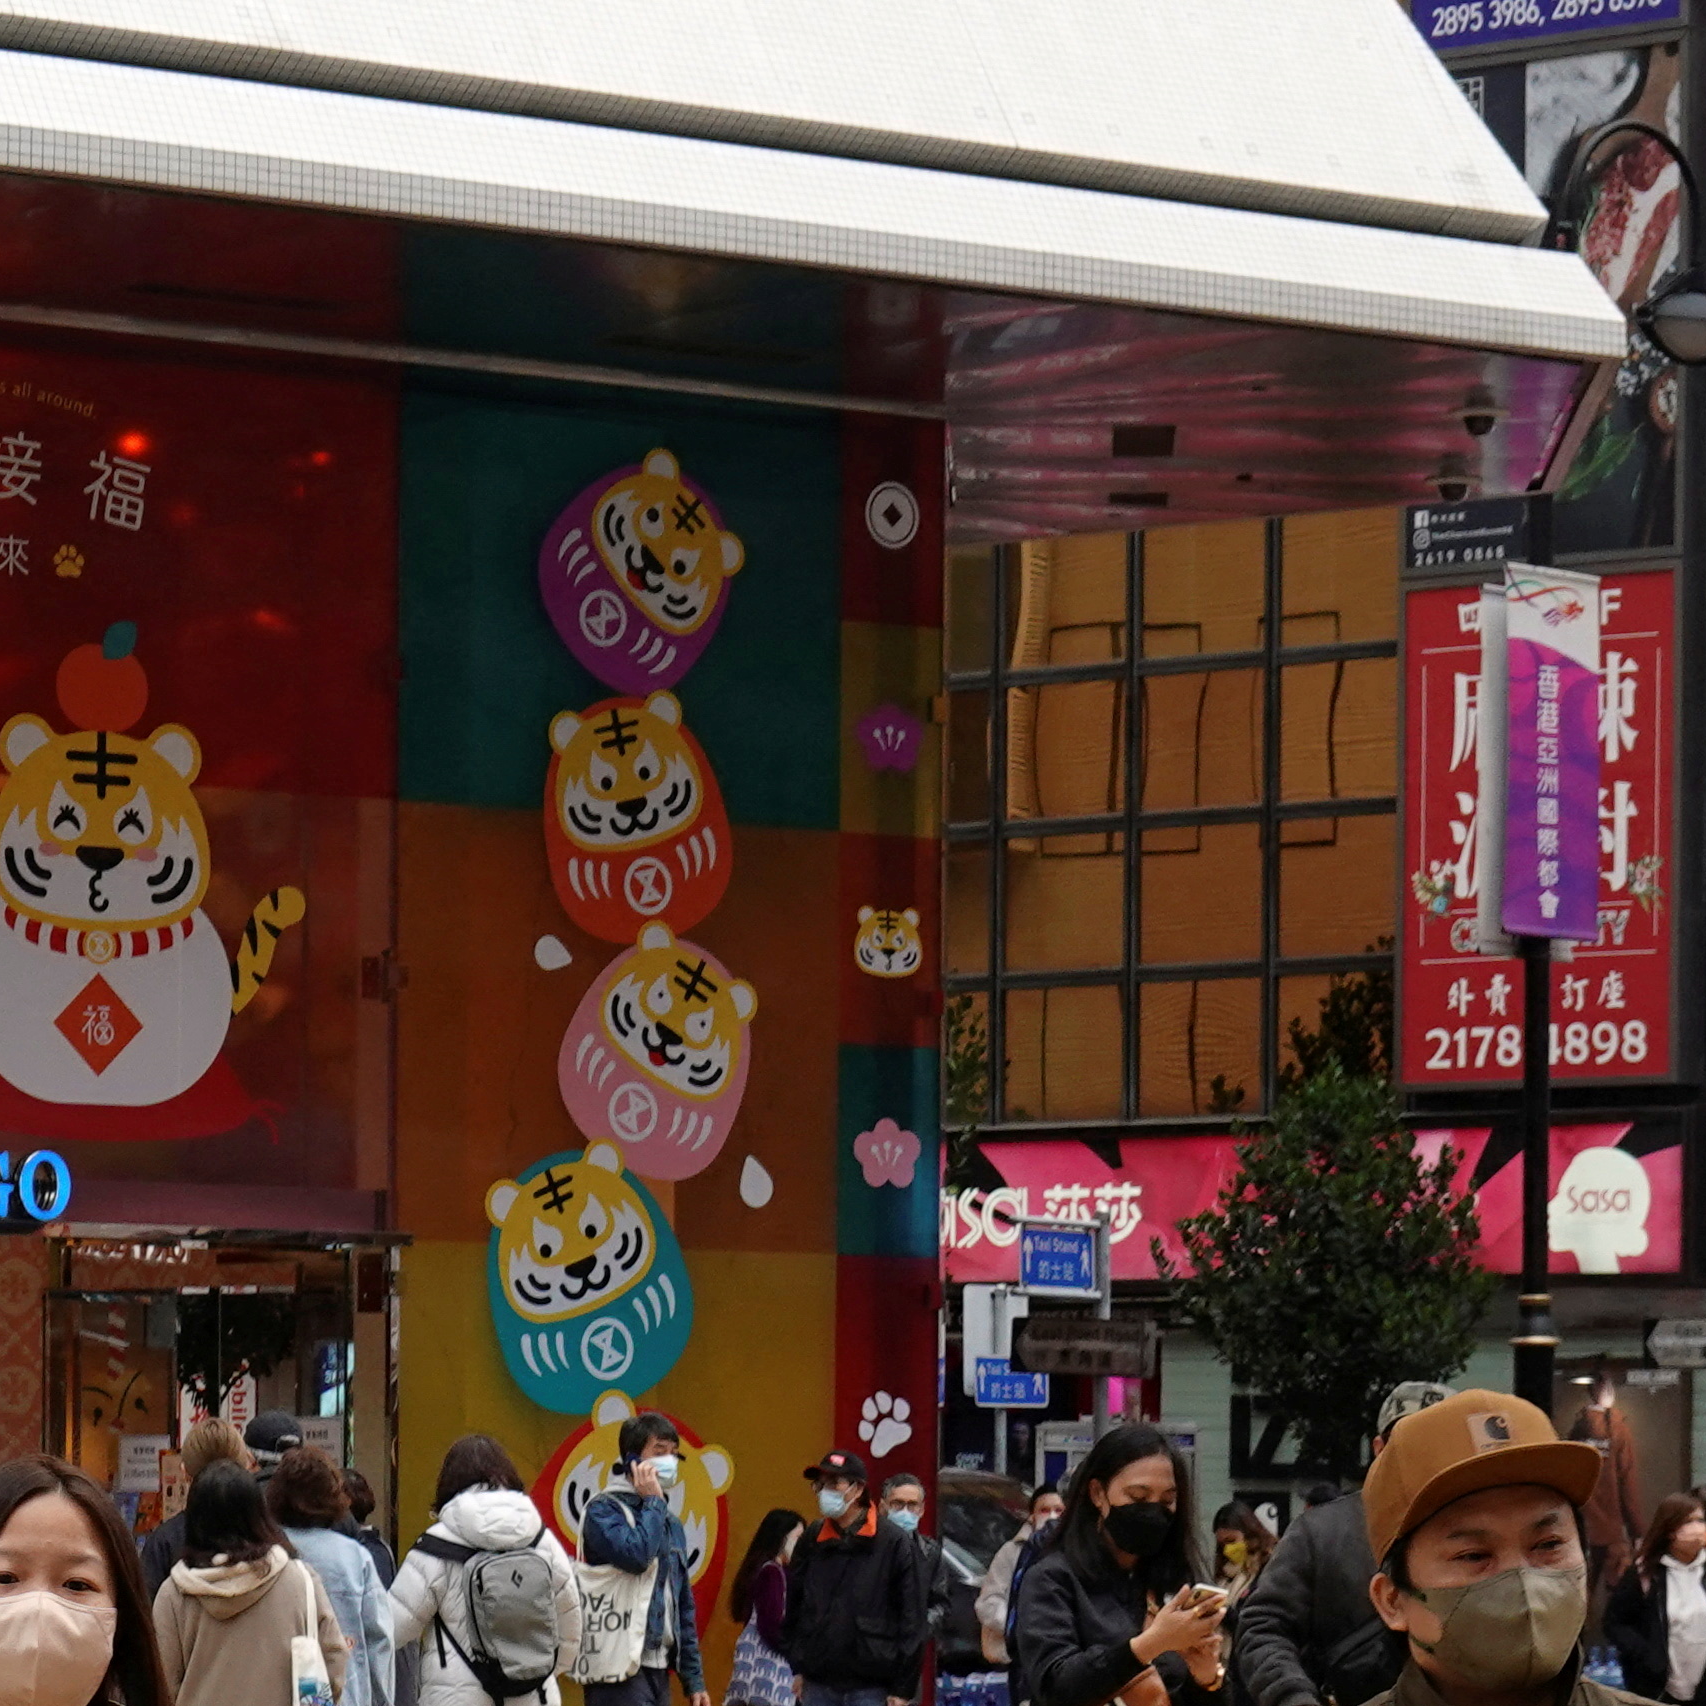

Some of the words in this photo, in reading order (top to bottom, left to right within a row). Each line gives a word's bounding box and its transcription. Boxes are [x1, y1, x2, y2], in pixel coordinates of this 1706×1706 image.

[1431, 2, 1484, 38] 2895
[12, 382, 32, 398] all
[1536, 664, 1561, 919] 香港亞洲國際都會
[1559, 969, 1626, 1012] 訂座
[1425, 1023, 1523, 1071] 2178
[1033, 1234, 1052, 1252] Taxi
